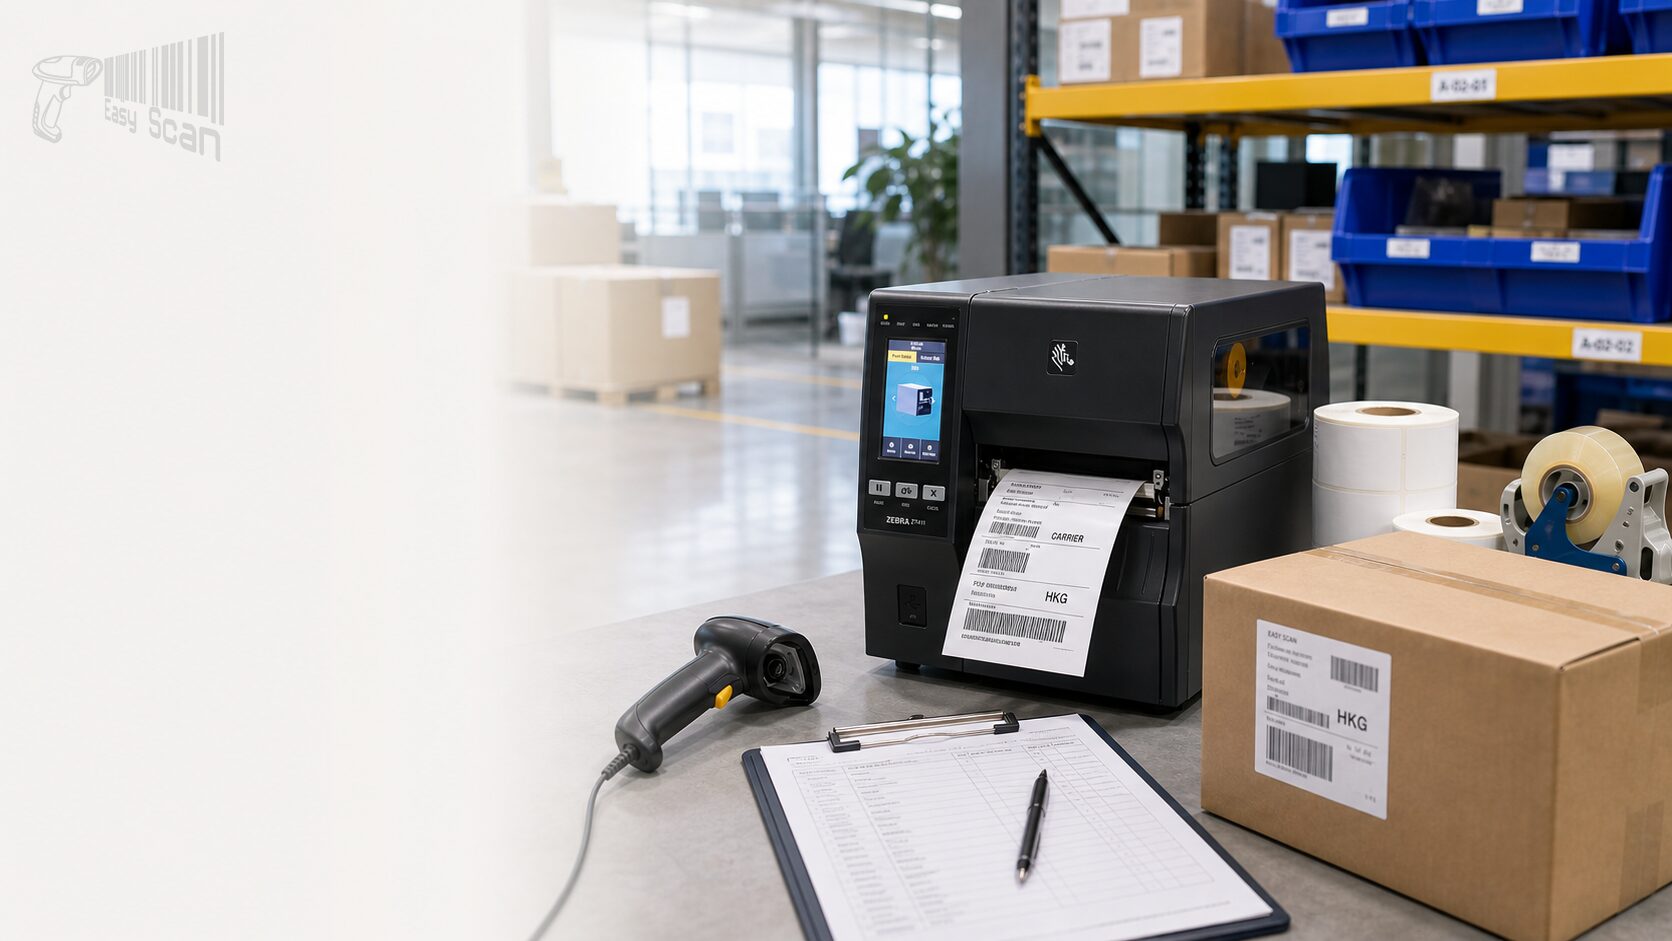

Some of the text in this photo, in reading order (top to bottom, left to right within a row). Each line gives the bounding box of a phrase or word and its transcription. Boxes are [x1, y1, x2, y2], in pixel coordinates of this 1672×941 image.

[886, 515, 910, 526] ZEBRA
[1051, 531, 1085, 543] CARRIER
[1045, 591, 1068, 604] HKG
[1282, 634, 1298, 644] SCAN
[1337, 708, 1368, 732] HKG
